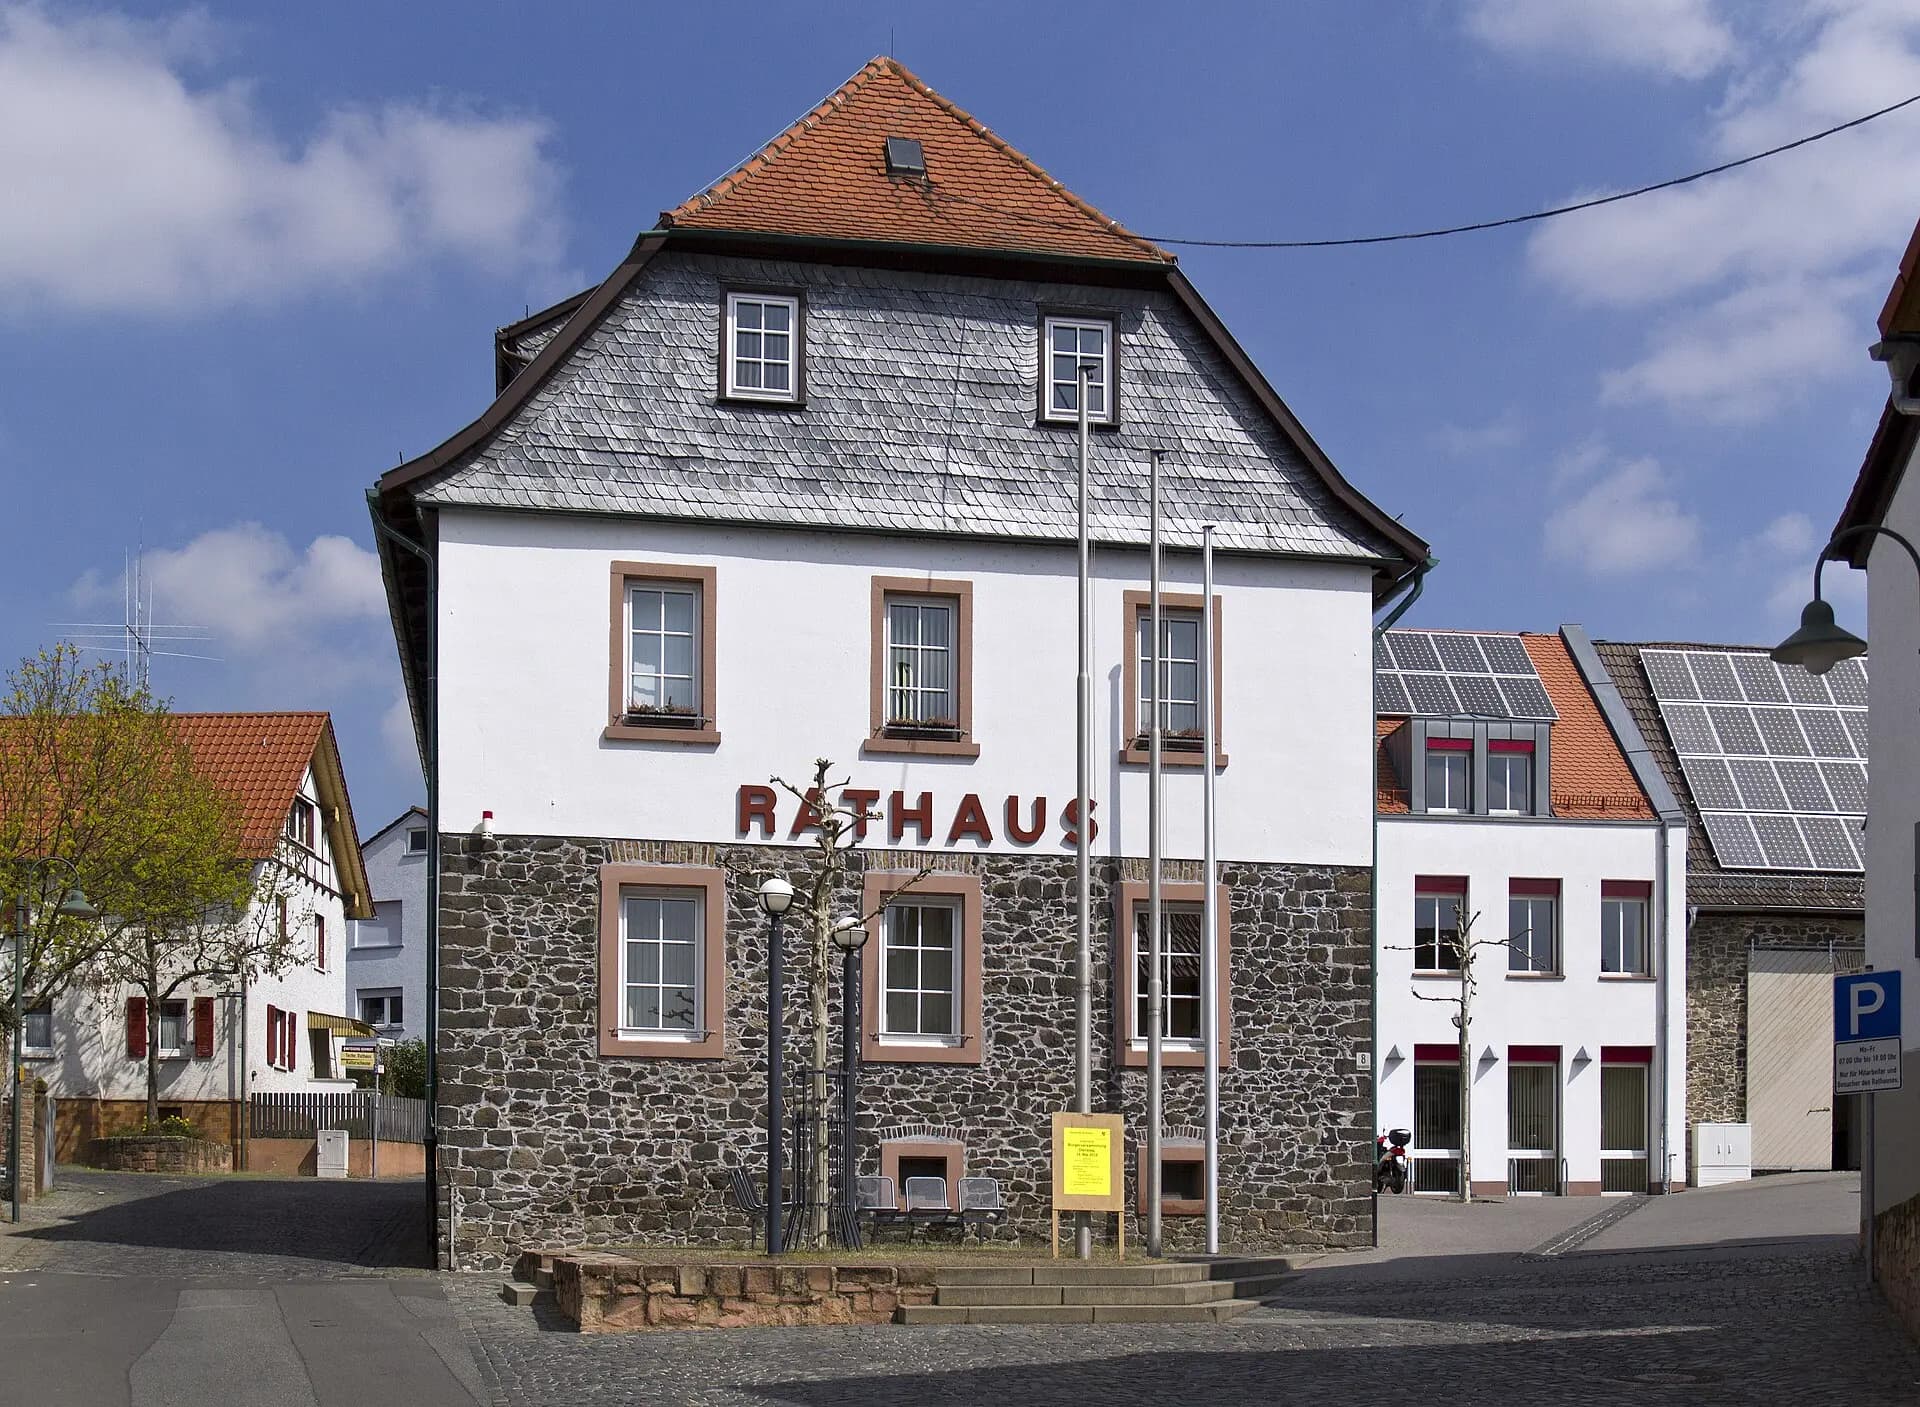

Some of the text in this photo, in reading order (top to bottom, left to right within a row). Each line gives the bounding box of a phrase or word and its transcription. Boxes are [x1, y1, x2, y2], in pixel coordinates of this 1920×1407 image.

[739, 784, 1099, 845] RATHAUS
[1850, 982, 1885, 1035] P
[1361, 1054, 1366, 1064] 8
